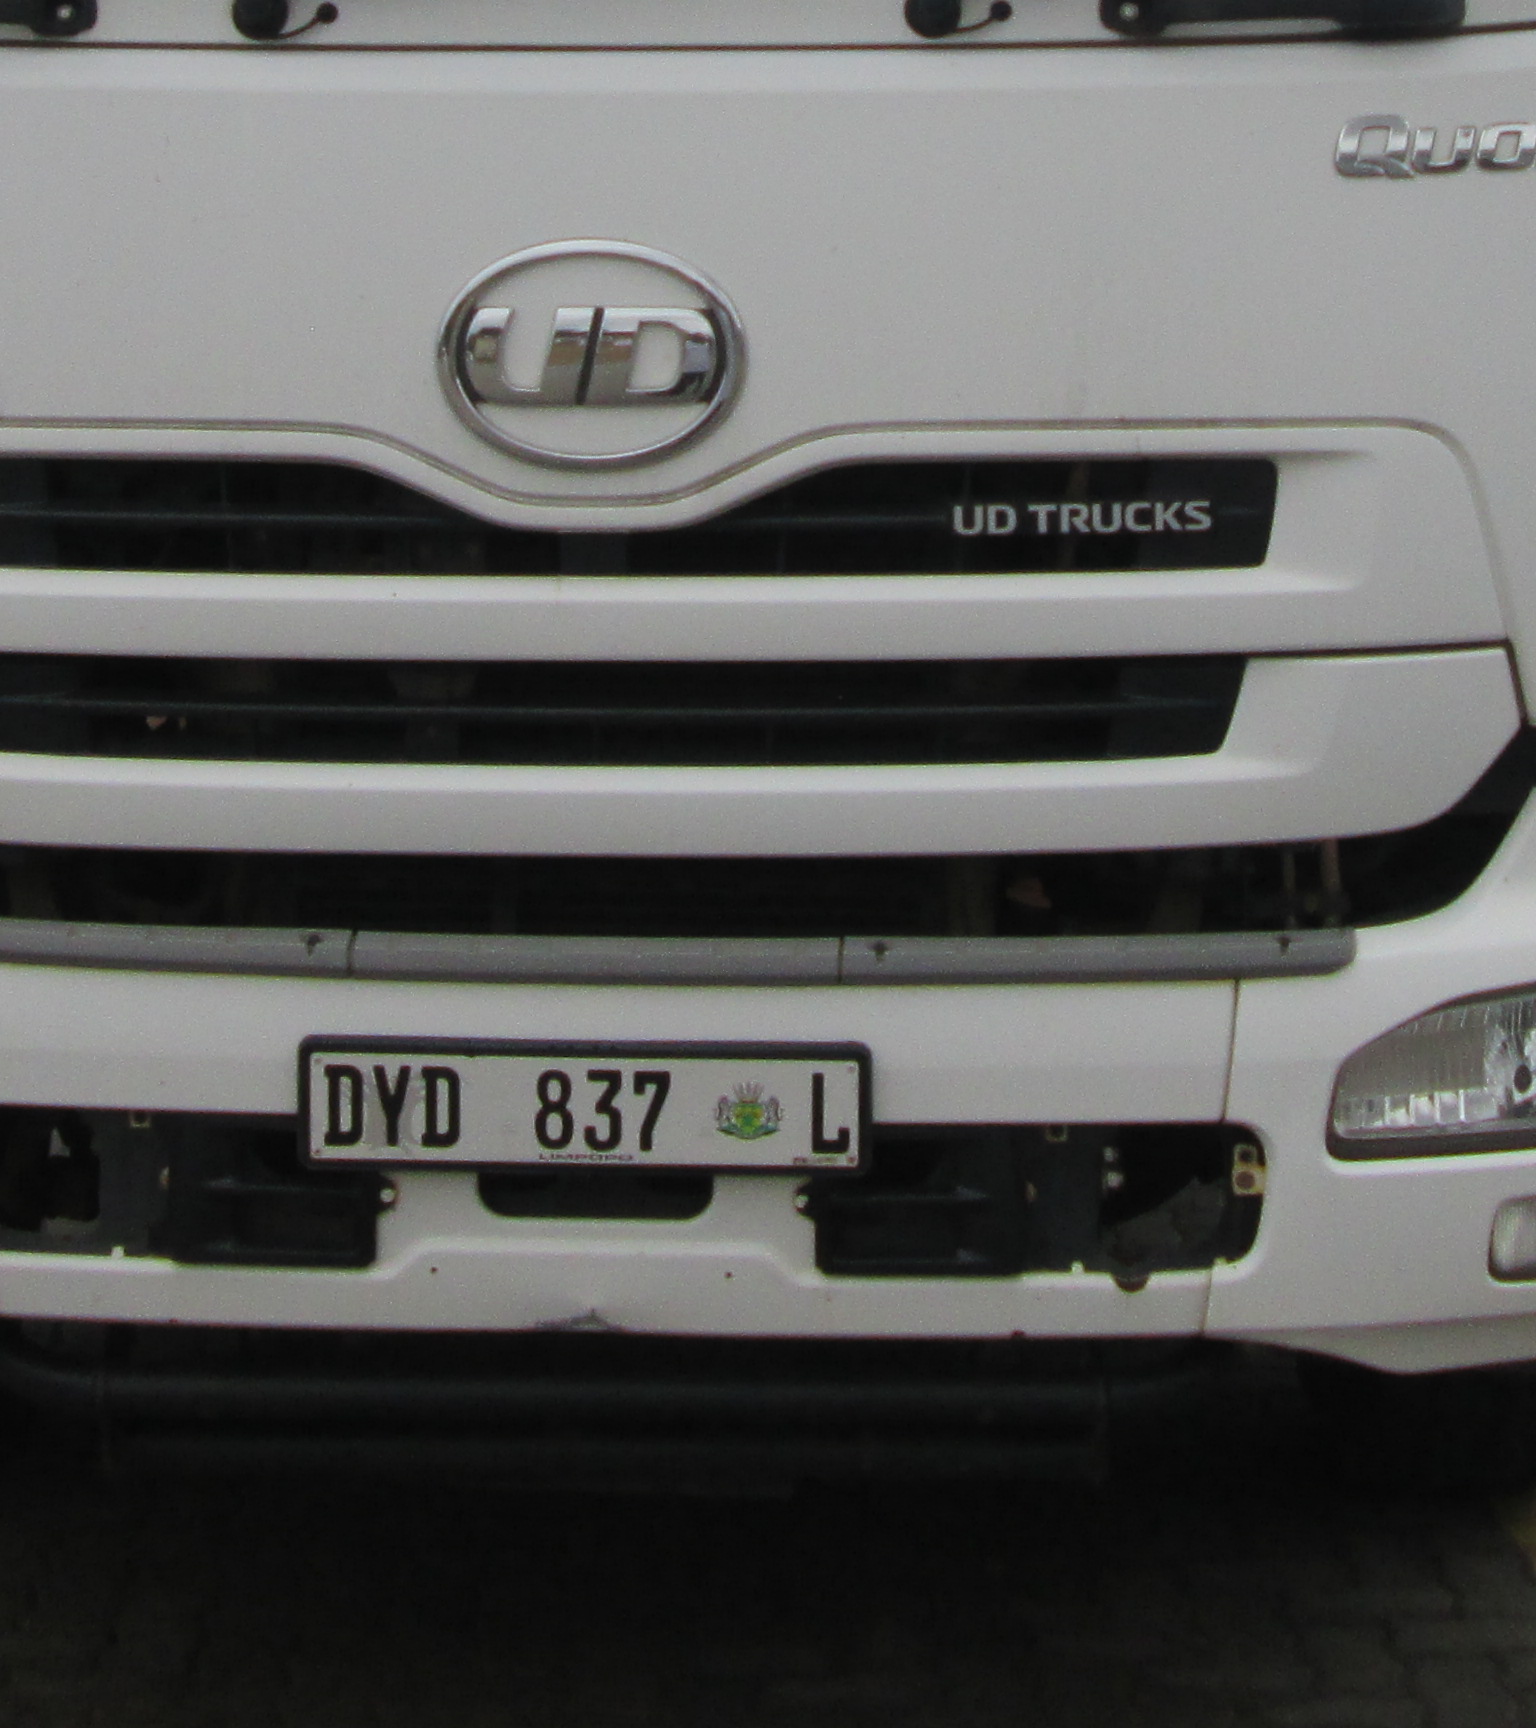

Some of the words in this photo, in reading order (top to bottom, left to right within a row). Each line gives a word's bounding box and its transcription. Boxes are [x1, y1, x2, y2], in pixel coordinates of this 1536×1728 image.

[466, 307, 716, 405] UD
[952, 503, 1017, 536] UD
[1027, 500, 1212, 534] TRUCKS
[323, 1064, 461, 1148] DYD
[534, 1069, 672, 1152] 837
[811, 1072, 851, 1154] L
